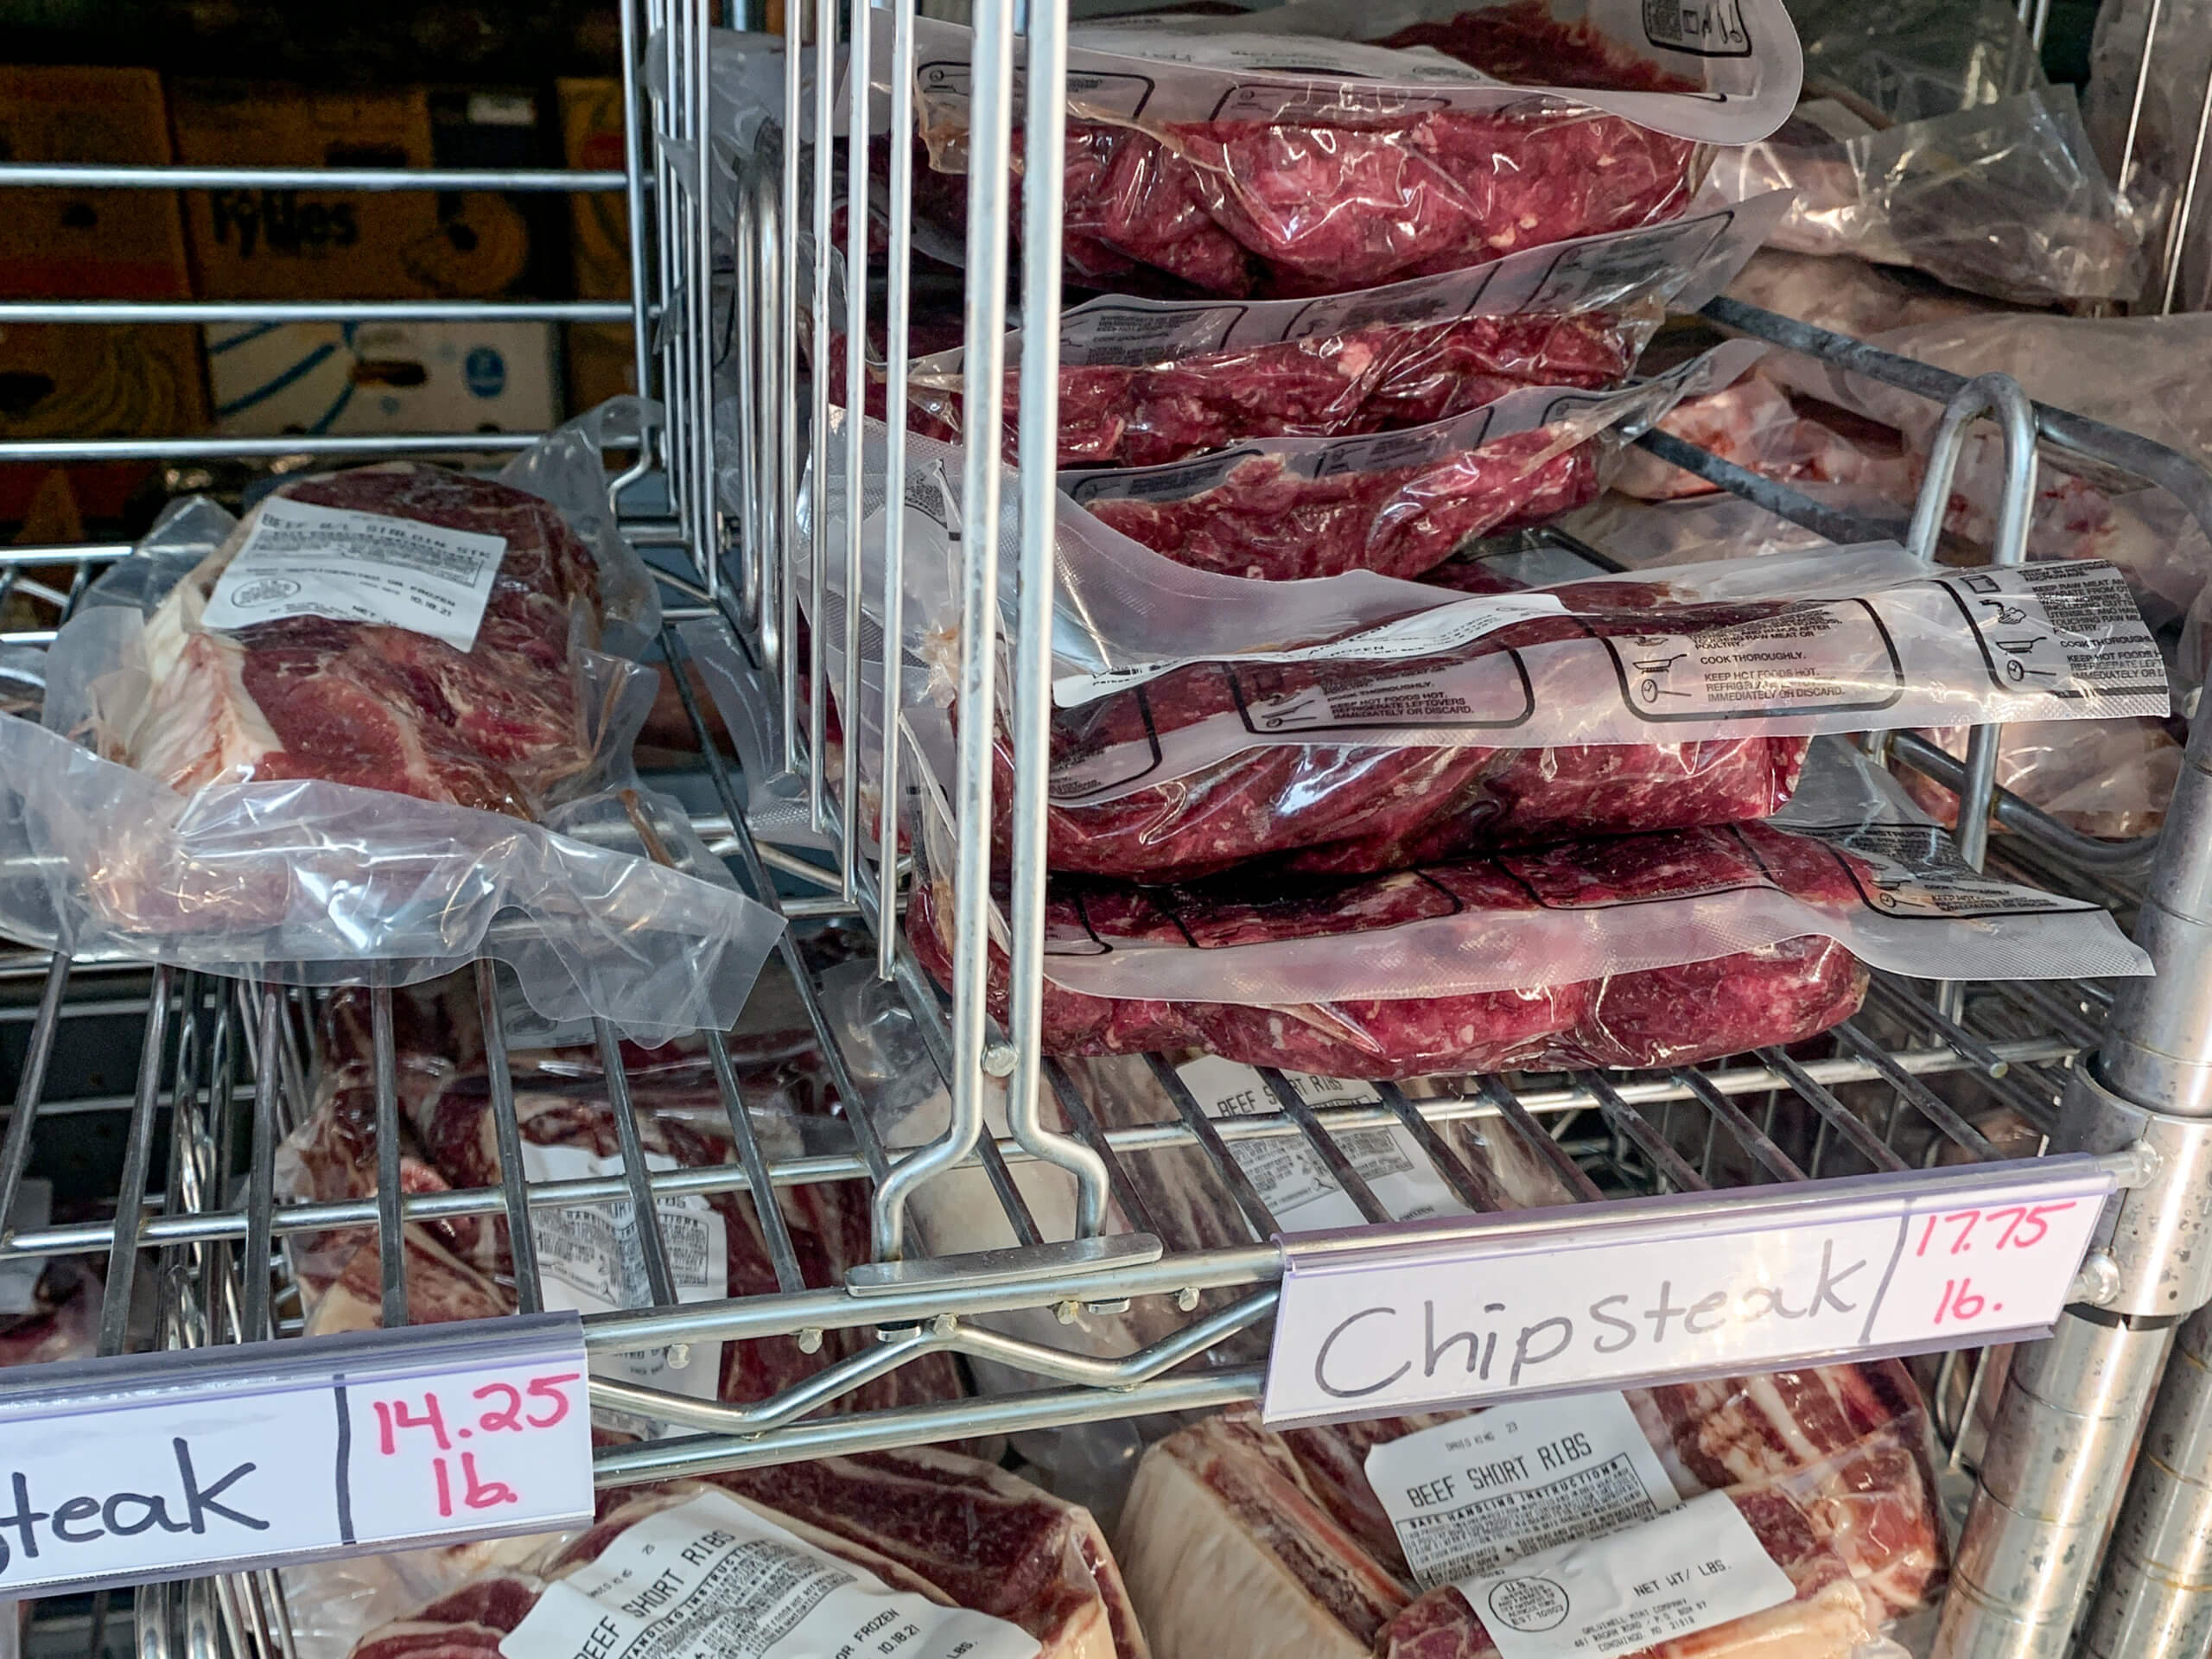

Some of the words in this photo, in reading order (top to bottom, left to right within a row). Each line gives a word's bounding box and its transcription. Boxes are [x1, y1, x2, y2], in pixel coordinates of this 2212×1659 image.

[1700, 655, 1732, 665] COOK
[1734, 652, 1807, 664] THOROUGHLY.
[1705, 671, 1731, 683] KEEP
[1758, 669, 1793, 679] FOODS
[1796, 666, 1820, 677] HOT.
[2067, 654, 2093, 664] KEEP
[2094, 652, 2115, 662] HOT
[2118, 650, 2152, 659] FOODS
[1333, 709, 1403, 720] IMMEDIATELY
[1407, 707, 1423, 716] OR
[1425, 705, 1474, 716] DISCARD.
[1384, 693, 1421, 702] FOODS
[1422, 691, 1447, 700] HOT.
[1405, 697, 1466, 708] LEFTOVERS
[1708, 690, 1777, 702] IMMEDIATELY
[1779, 689, 1795, 698] OR
[1797, 686, 1846, 697] DISCARD.
[1217, 1090, 1257, 1117] BEEF
[1263, 1077, 1309, 1106] SRT
[1916, 1201, 2077, 1257] 17.75
[372, 1372, 582, 1455] 14.25
[432, 1452, 518, 1516] lb.
[1407, 1474, 1455, 1508] BEEF
[1466, 1455, 1529, 1491] SHORT
[1536, 1432, 1593, 1471] RIBS
[0, 1436, 270, 1576] teak
[1409, 1516, 1443, 1530] SAFE
[1447, 1492, 1516, 1522] HANDLING
[1519, 1461, 1619, 1502] INSTRUCTIONS
[621, 1567, 686, 1618] SHORT
[681, 1529, 738, 1567] RIBS
[1633, 1580, 1661, 1598] NET
[1665, 1567, 1690, 1587] WT/
[1697, 1559, 1732, 1577] LBS.
[835, 1643, 856, 1659] OR
[853, 1606, 901, 1643] FROZEN
[877, 1624, 921, 1656] 10.18.21
[946, 1639, 980, 1659] LBS.
